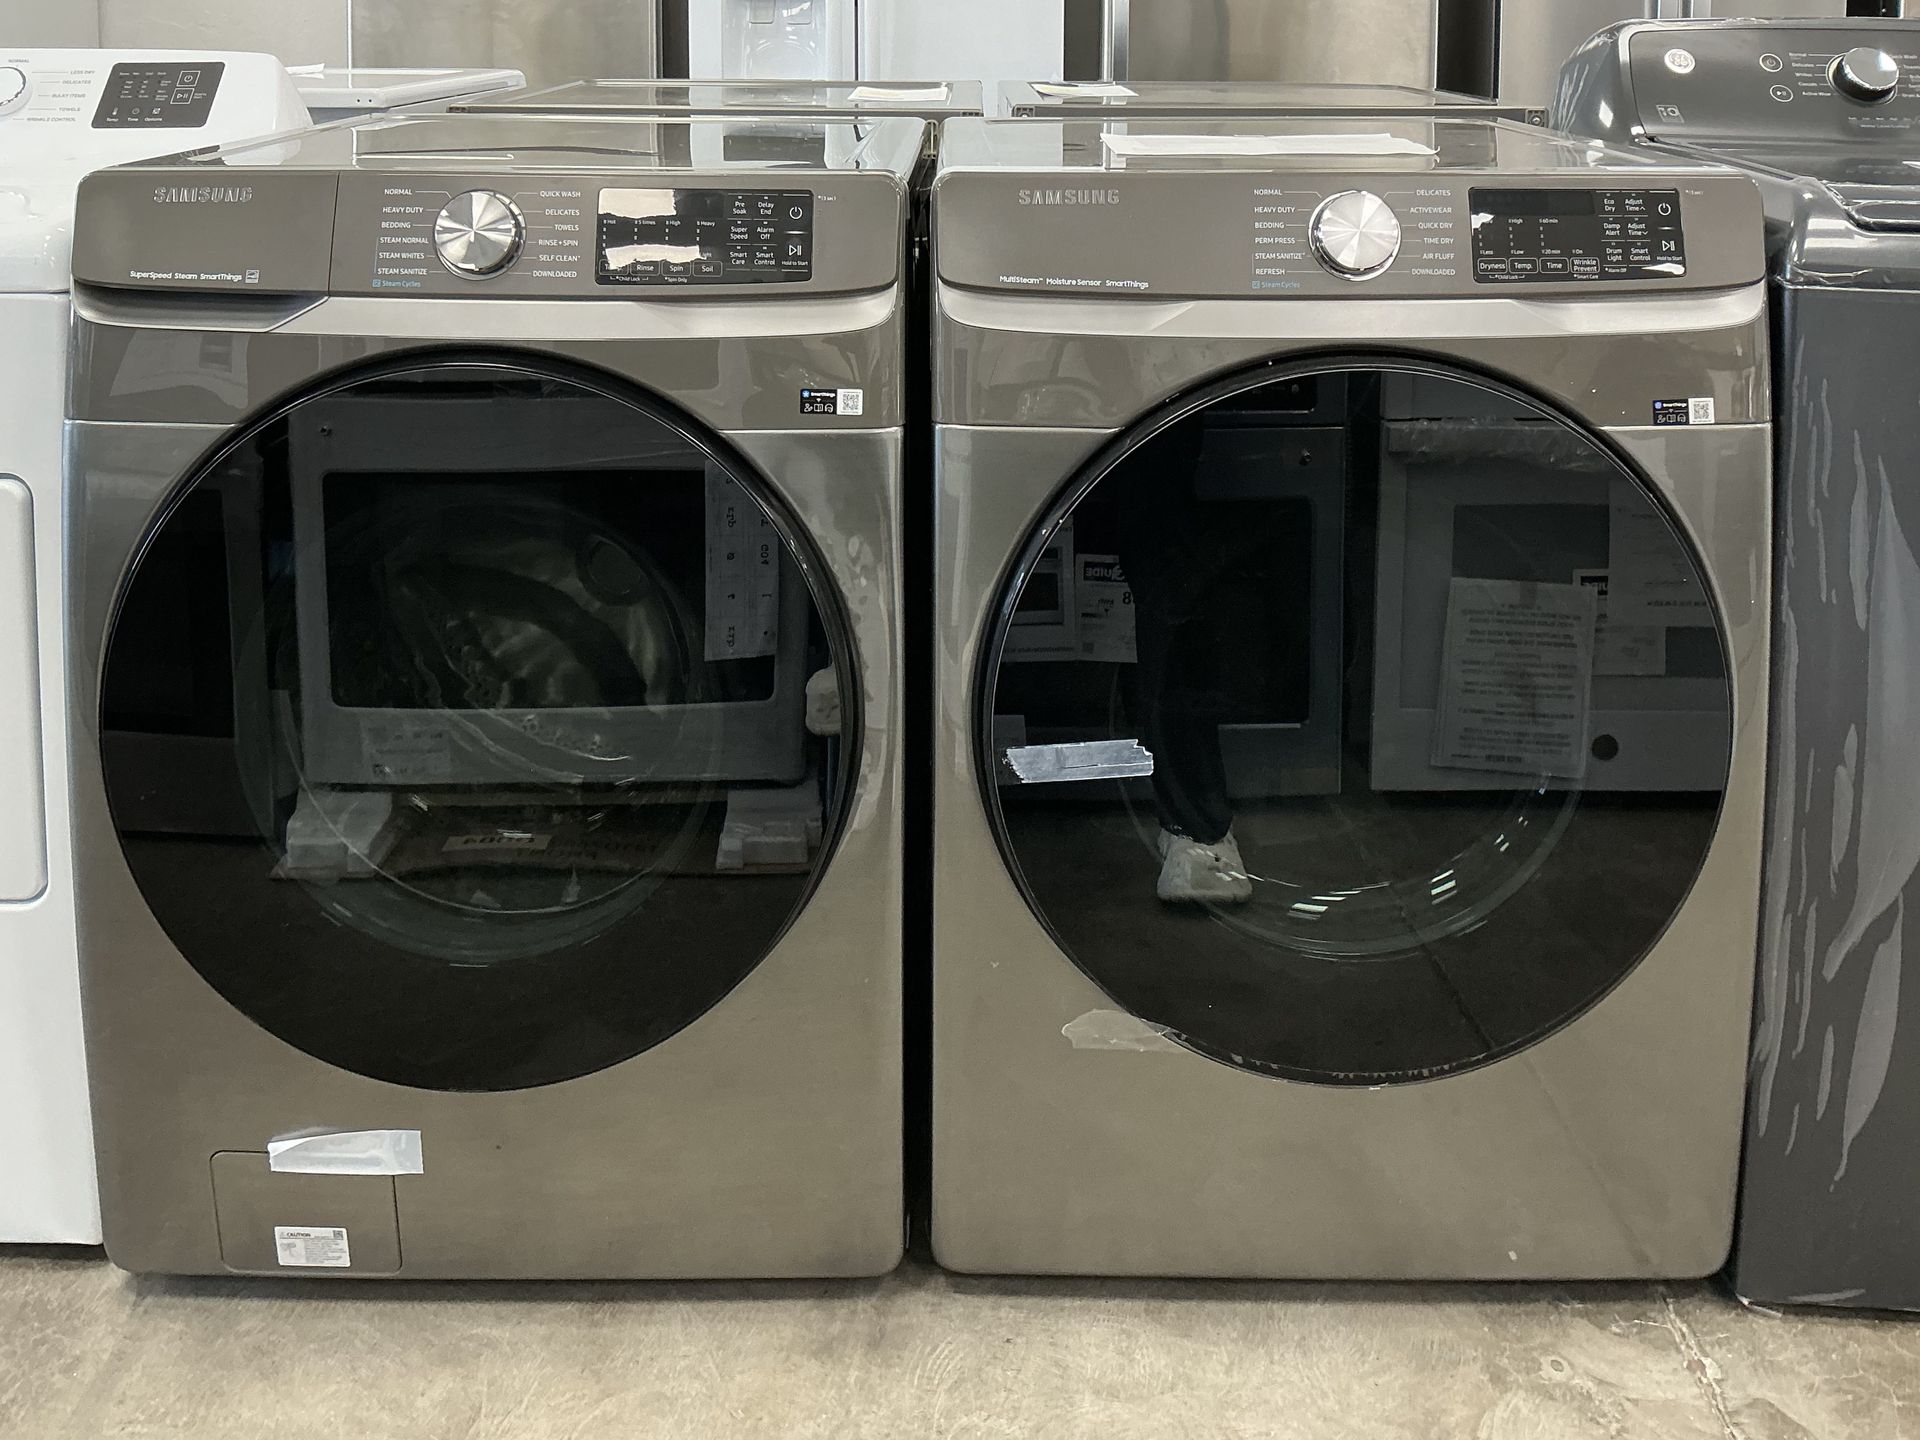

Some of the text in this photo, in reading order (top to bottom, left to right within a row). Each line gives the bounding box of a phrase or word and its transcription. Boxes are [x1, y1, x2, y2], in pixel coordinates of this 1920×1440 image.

[153, 186, 252, 203] SAMSUNG
[1018, 189, 1120, 205] SAMSUNG
[563, 239, 579, 247] SPIN
[1480, 262, 1505, 270] Dryness
[1514, 262, 1533, 270] Temp.
[130, 270, 242, 283] SuperSpeed Steam SmartThings
[1046, 278, 1077, 286] Moisture
[1077, 278, 1102, 287] Sensor
[1105, 279, 1149, 289] SmartThings
